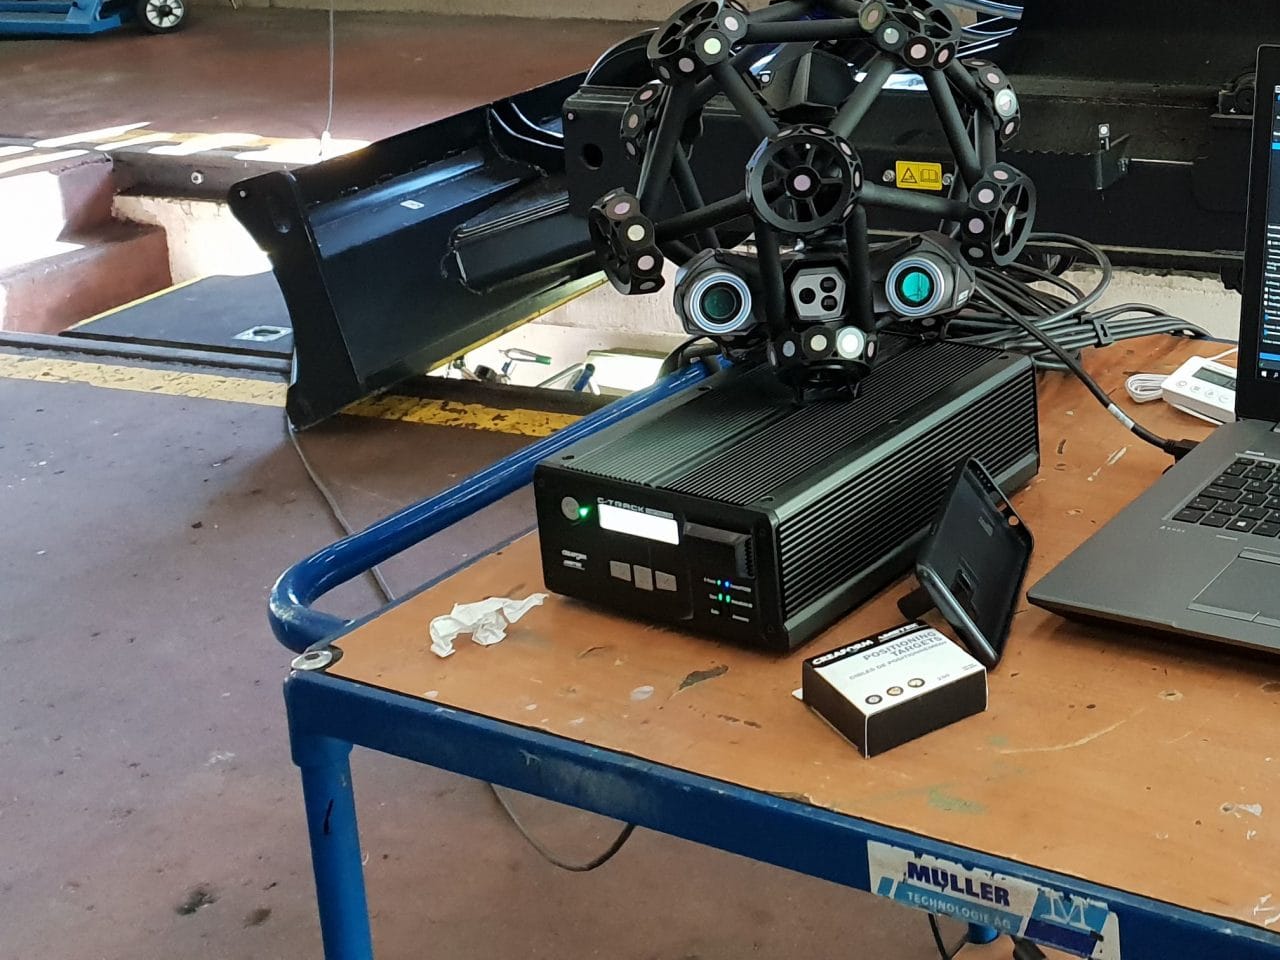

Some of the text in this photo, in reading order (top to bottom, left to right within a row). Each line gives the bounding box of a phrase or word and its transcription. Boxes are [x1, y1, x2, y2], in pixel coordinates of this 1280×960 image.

[863, 630, 938, 661] POSITIONING
[892, 635, 943, 658] TARGETS
[906, 890, 1011, 930] TECHNOLOGIE AG
